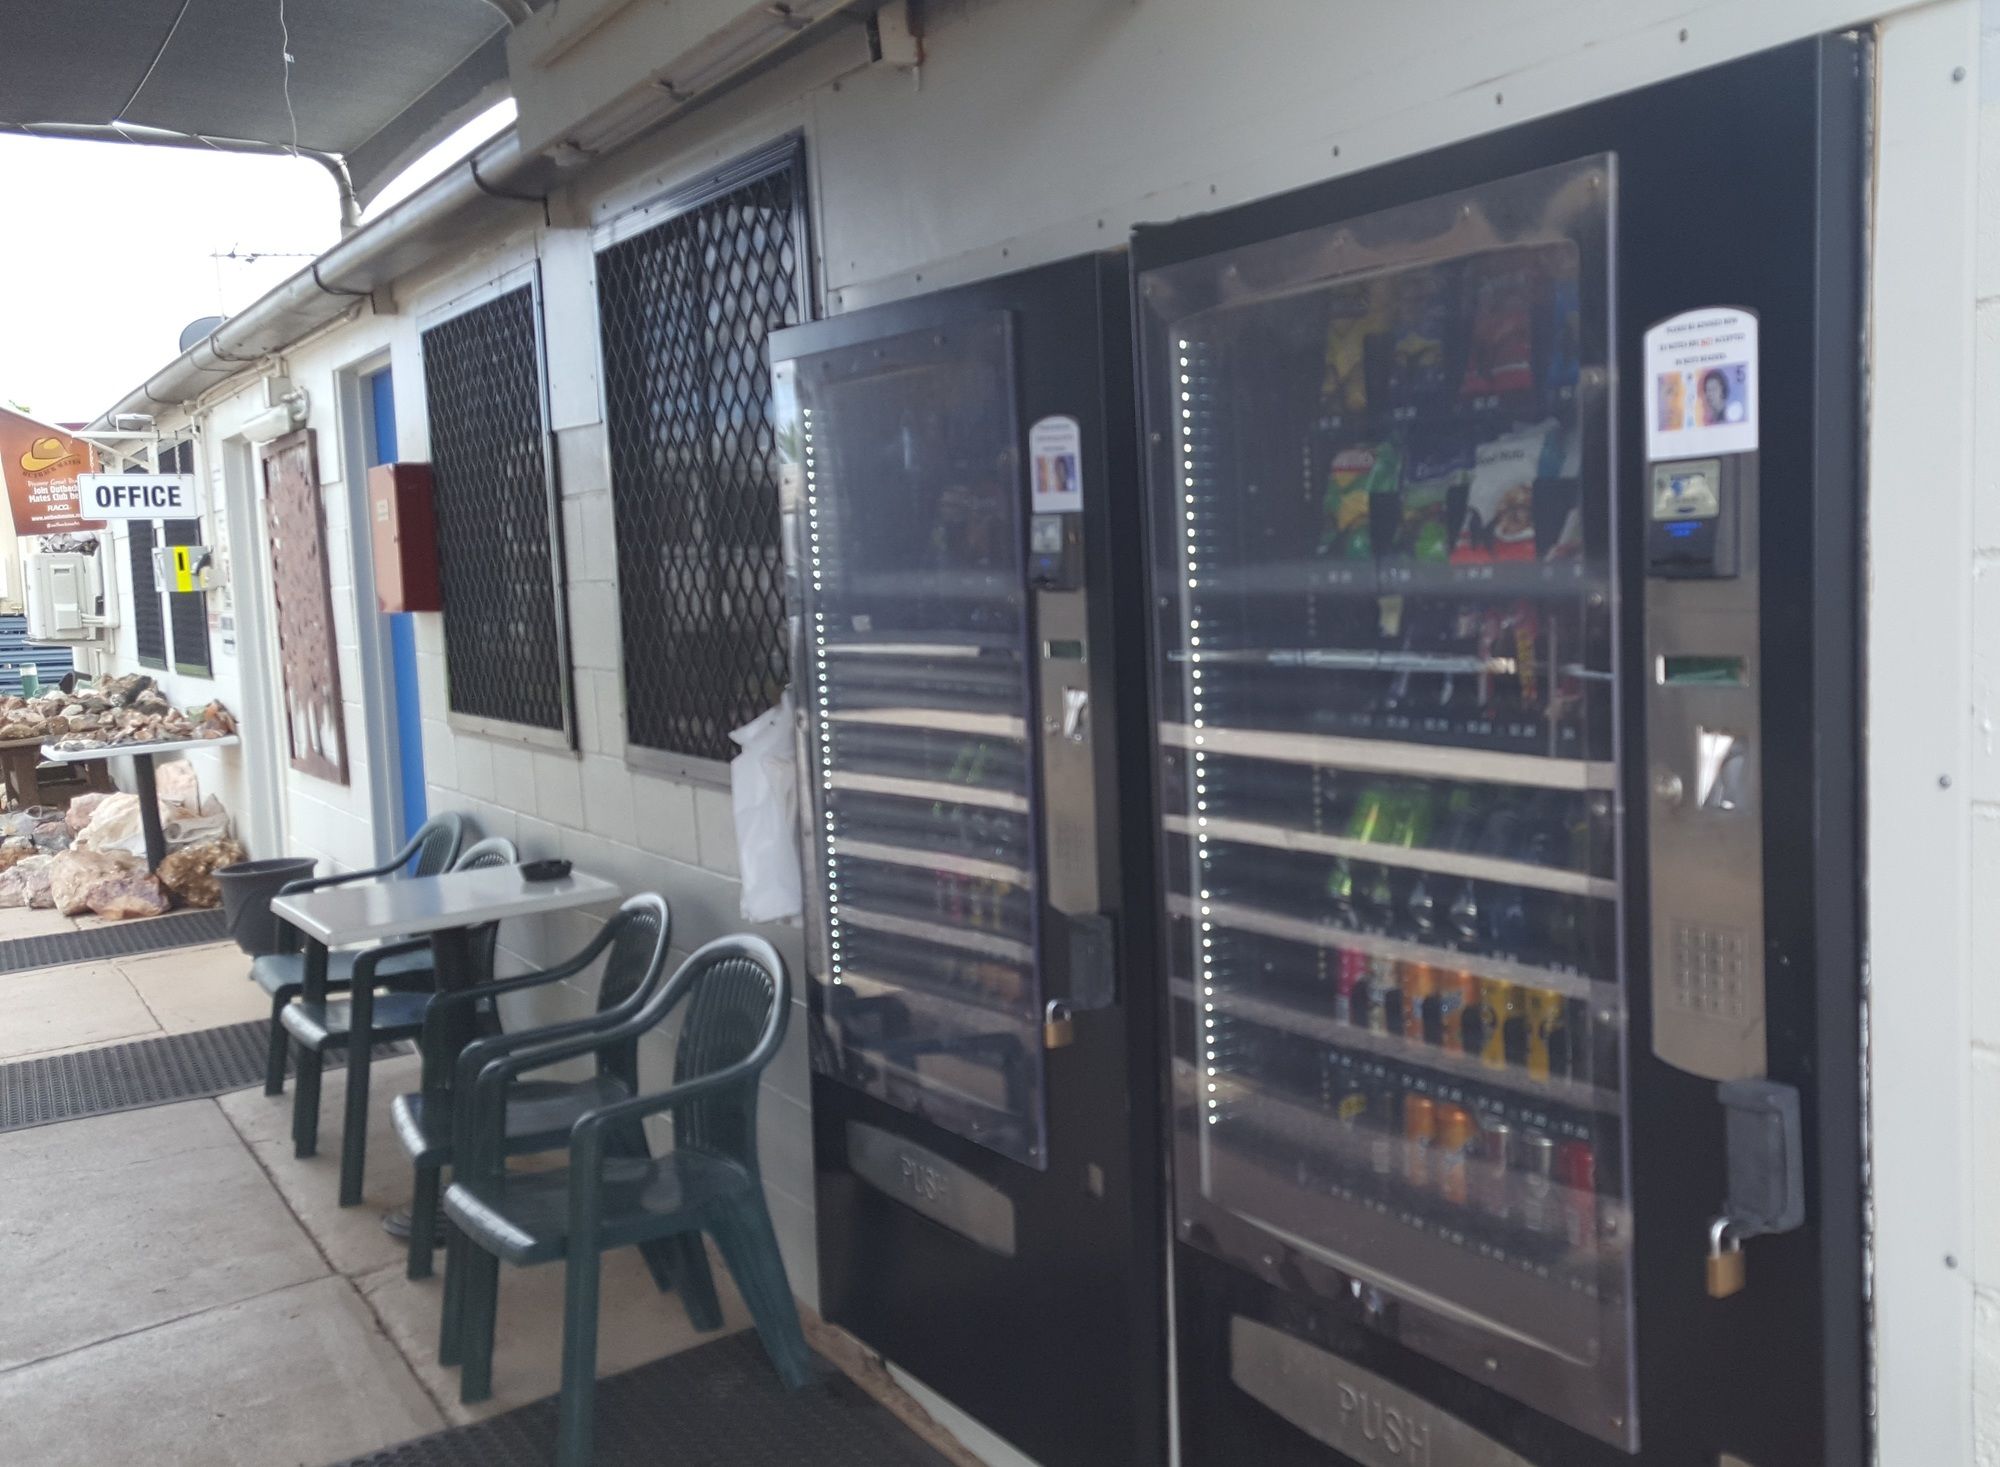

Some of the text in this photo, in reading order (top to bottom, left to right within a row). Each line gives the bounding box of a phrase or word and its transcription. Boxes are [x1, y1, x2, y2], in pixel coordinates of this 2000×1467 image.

[29, 494, 51, 503] Mates
[52, 492, 68, 501] Club
[33, 486, 48, 495] Join
[95, 485, 182, 508] OFFICE
[1337, 1381, 1431, 1467] PUSH
